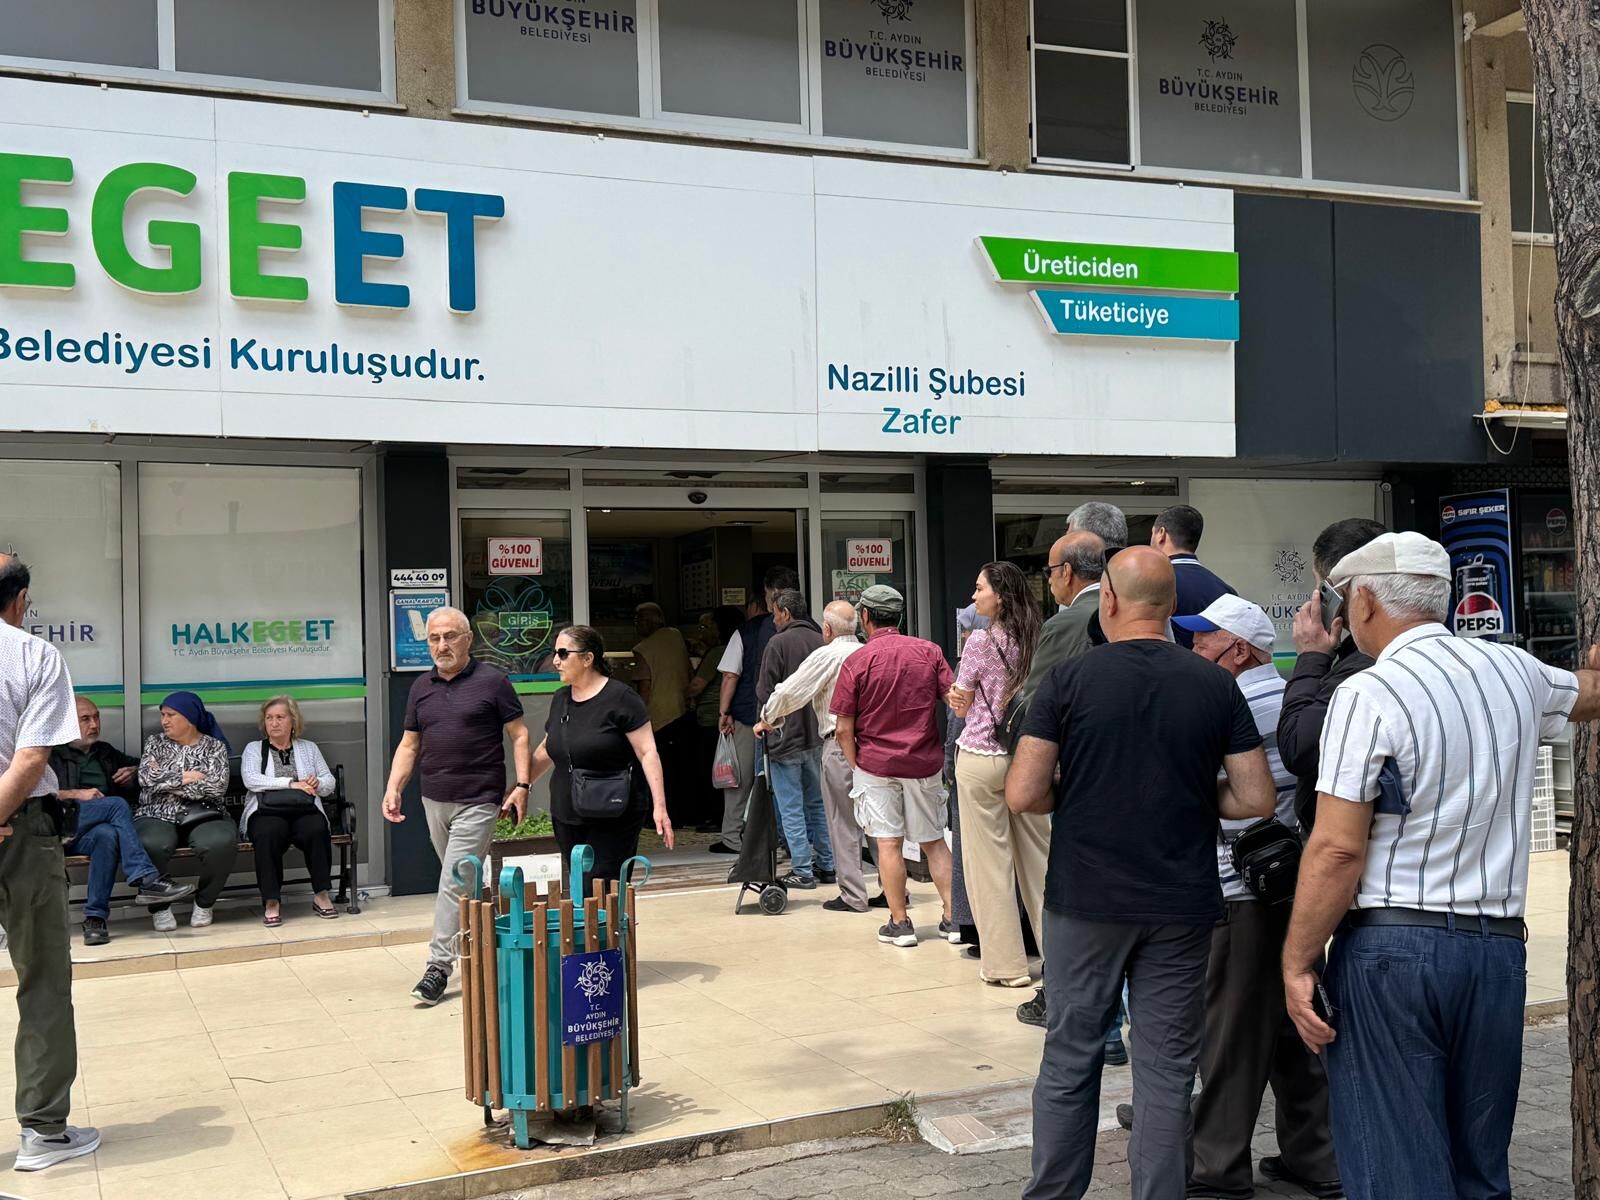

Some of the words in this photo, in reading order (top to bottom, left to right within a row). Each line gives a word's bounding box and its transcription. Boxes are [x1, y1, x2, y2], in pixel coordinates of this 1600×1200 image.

[520, 26, 591, 43] BELEDİYESİ
[868, 30, 887, 41] T.C.
[890, 33, 922, 45] AYDIN
[825, 38, 963, 72] BÜYÜKŞEHİR
[865, 66, 926, 82] BELEDİYESİ
[1197, 68, 1213, 78] T.C.
[1215, 71, 1243, 81] AYDIN
[1159, 76, 1279, 106] BÜYÜKŞEHİR
[1194, 102, 1247, 116] BELEDİYESİ
[1023, 249, 1139, 280] Üreticiden
[1060, 299, 1169, 328] Tüketiciye
[230, 337, 485, 384] Kuruluşudur.
[828, 363, 919, 393] Nazilli
[928, 367, 1026, 400] Şubesi
[882, 407, 962, 435] Zafer
[1479, 504, 1505, 516] ŞEKER
[498, 544, 531, 554] %100
[855, 544, 883, 554] %100
[491, 555, 540, 569] GÜVENLİ
[850, 555, 889, 567] GÜVENLİ
[393, 573, 413, 581] 444
[415, 573, 429, 581] 40
[431, 573, 445, 581] 09
[172, 619, 335, 645] HALKEGEET
[1456, 617, 1500, 632] PEPSI
[585, 1011, 606, 1020] AYDIN
[567, 1016, 619, 1033] BÜYÜKŞEHİR
[575, 1028, 614, 1043] BELEDİYESİ
